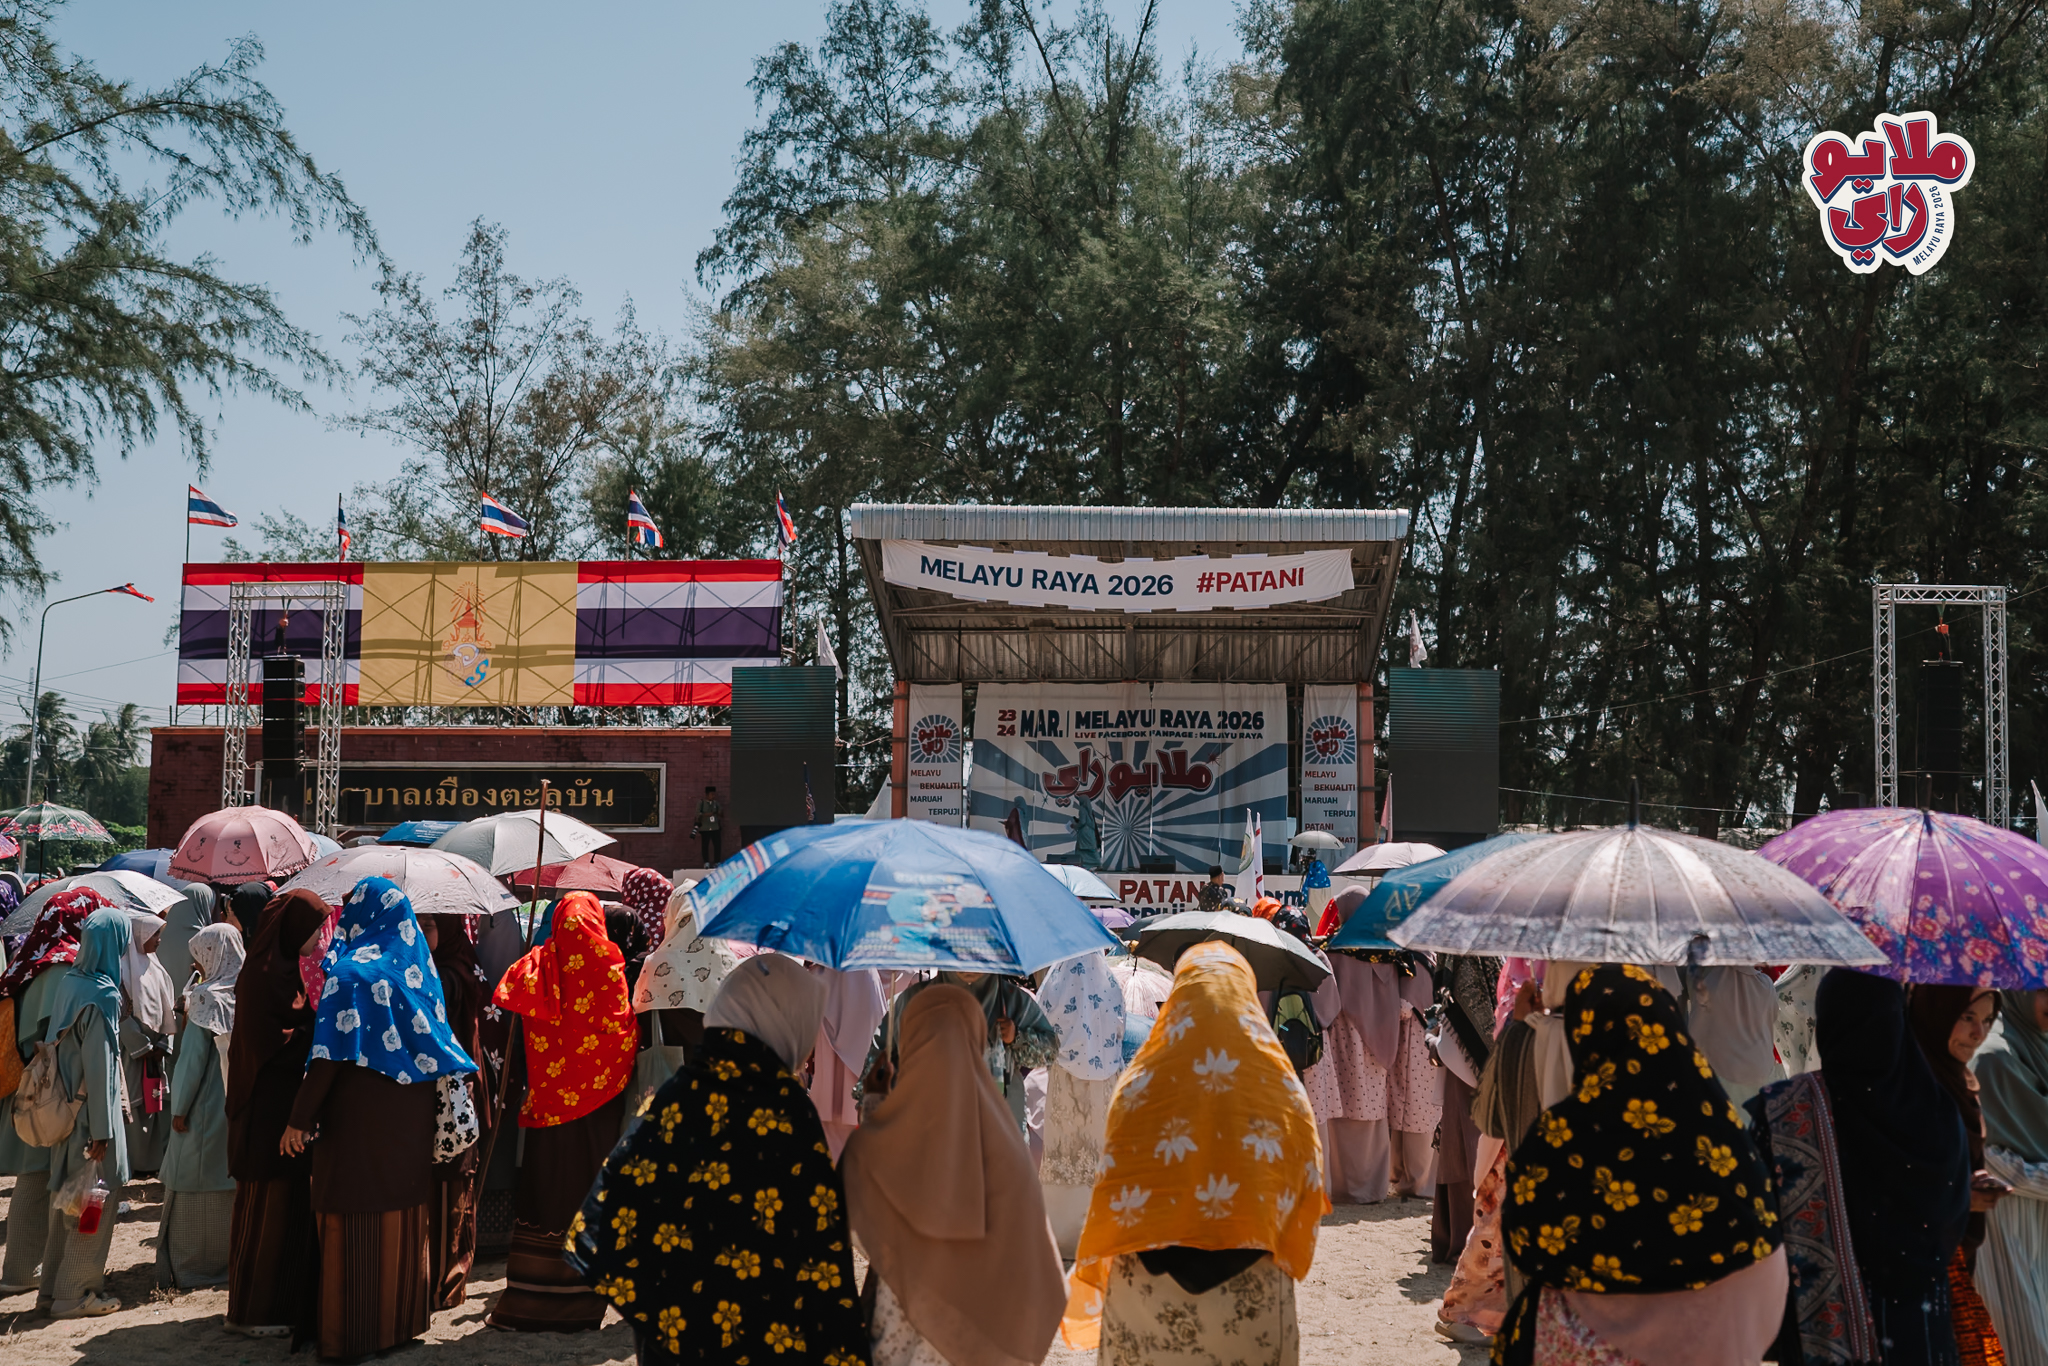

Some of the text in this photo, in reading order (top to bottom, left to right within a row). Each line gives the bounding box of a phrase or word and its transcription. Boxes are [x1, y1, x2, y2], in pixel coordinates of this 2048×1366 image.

[920, 555, 1304, 597] MELAYU RAYA 2026 #PATANI
[998, 709, 1016, 721] 23
[1019, 709, 1063, 738] MAR.
[1075, 709, 1265, 730] MELAYU RAYA 2026
[996, 724, 1016, 736] 24
[1098, 730, 1147, 738] FACEBOOK
[1199, 731, 1237, 739] MELAYU
[910, 769, 941, 777] MELAYU
[1304, 770, 1337, 778] MELAYU
[919, 782, 960, 790] BEKUALITI
[910, 795, 943, 803] MARUAH
[928, 808, 960, 816] TERPUJI
[1304, 823, 1334, 831] PATANI
